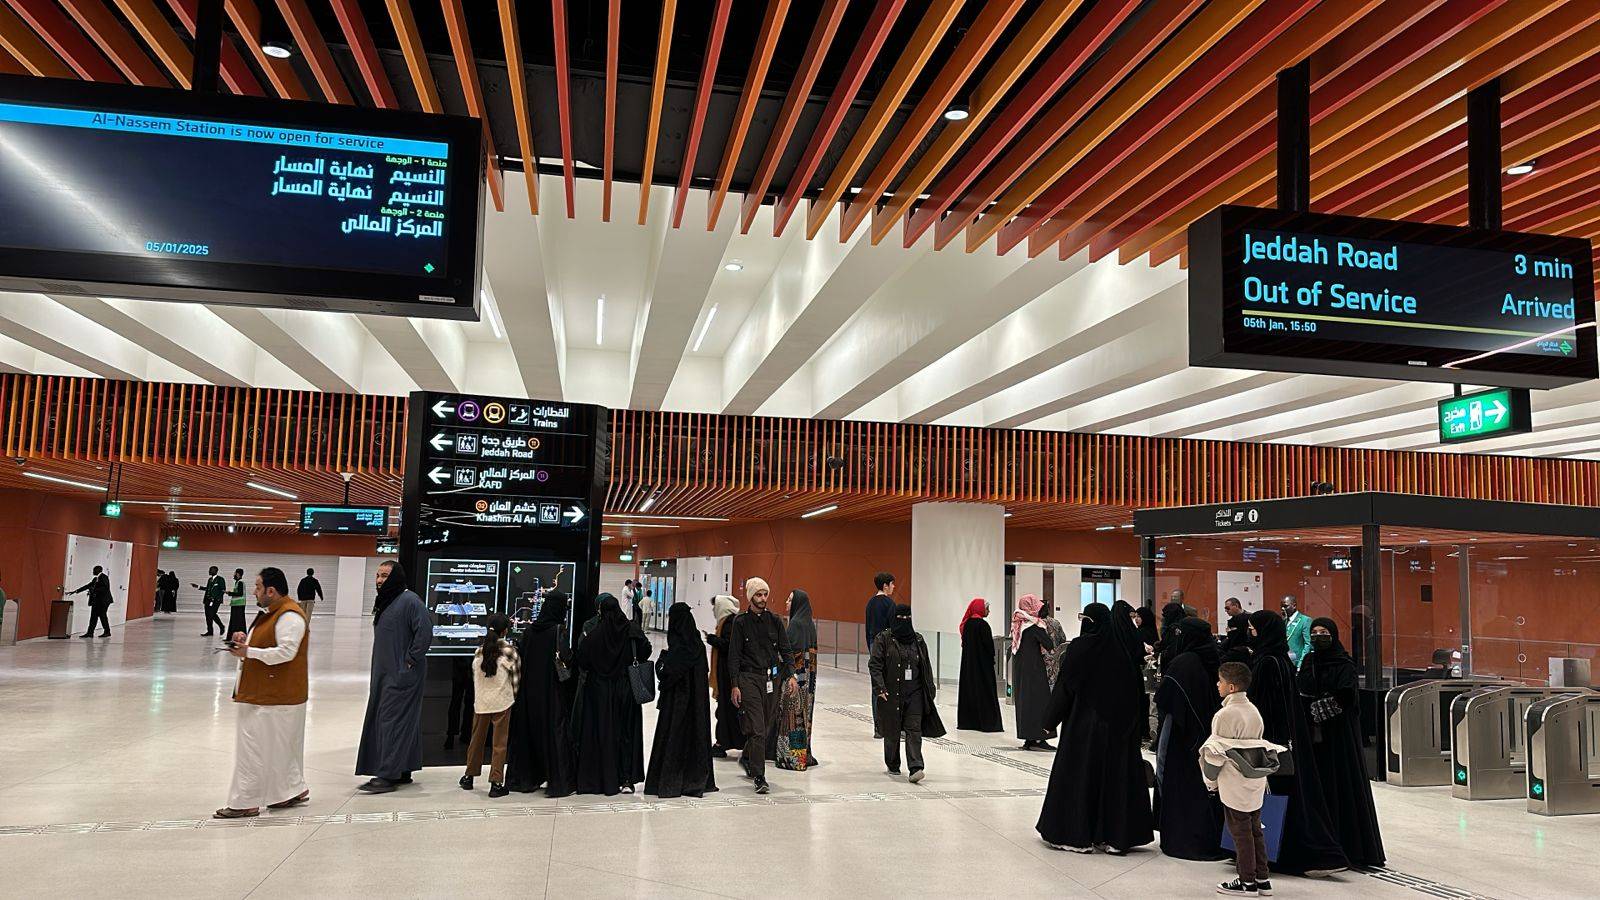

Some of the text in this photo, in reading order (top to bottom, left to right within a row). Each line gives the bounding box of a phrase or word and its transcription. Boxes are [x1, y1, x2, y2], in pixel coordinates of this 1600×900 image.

[92, 113, 385, 149] Al-Nassem Station is now open for service
[272, 155, 446, 186] النسيم نهاية المسار
[271, 176, 444, 207] النسيم نهاية المسار
[416, 209, 423, 217] 2
[394, 218, 443, 239] المركز
[146, 241, 209, 255] 05/01/2025
[1242, 233, 1398, 271] Jeddah Road
[1514, 254, 1573, 279] 3 min
[1244, 276, 1417, 314] Out of Service
[1501, 293, 1575, 320] Arrived
[1243, 317, 1266, 328] 05th
[1290, 320, 1317, 332] 15:50
[533, 406, 569, 418] القطارات
[533, 418, 558, 428] Trains
[481, 436, 500, 447] جدة
[502, 437, 526, 448] طريق
[481, 447, 534, 458] Jeddah Road
[509, 469, 535, 481] المركز
[479, 480, 503, 489] KAFD
[476, 513, 536, 523] Khashm Al An
